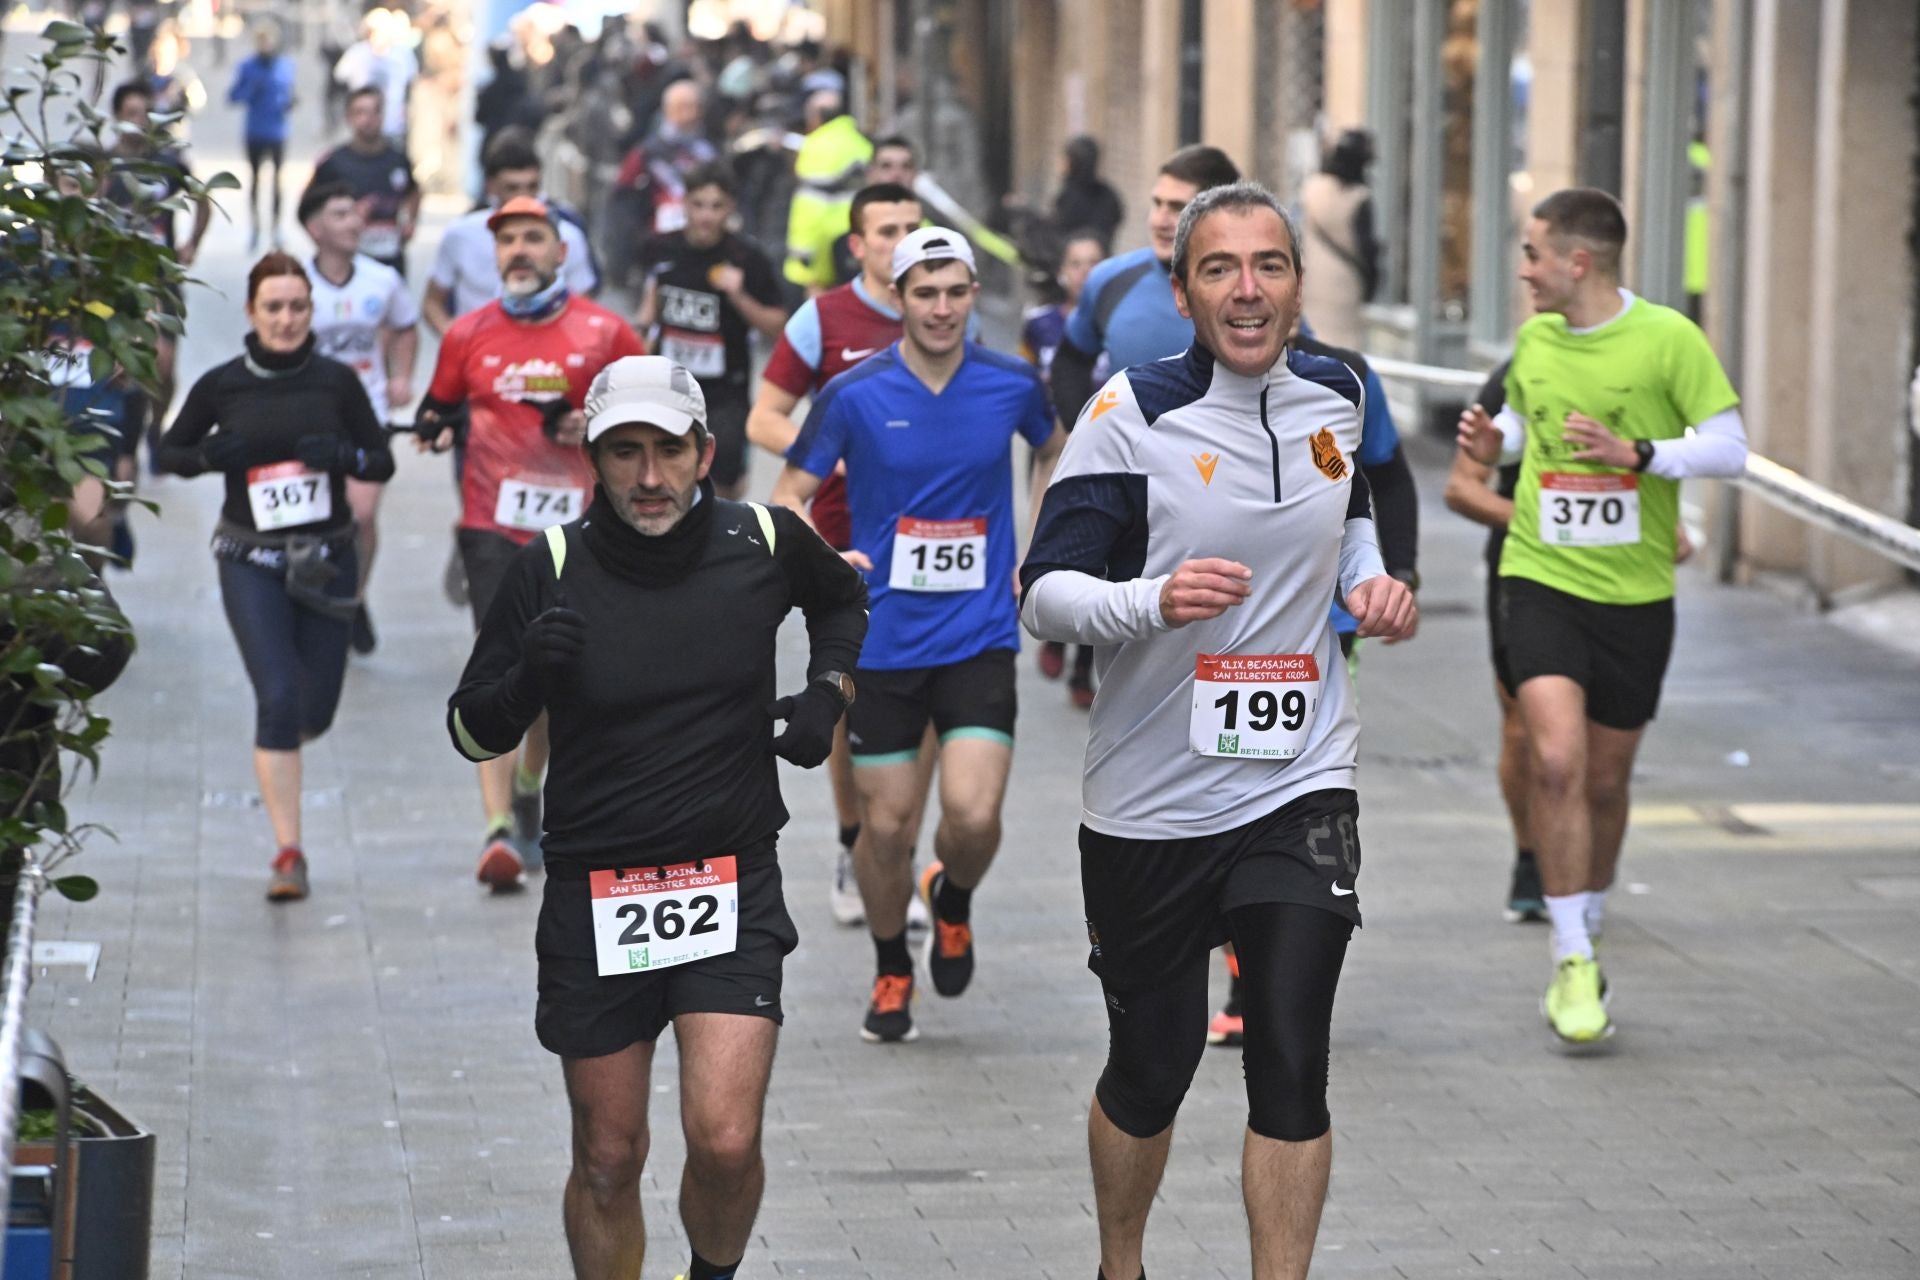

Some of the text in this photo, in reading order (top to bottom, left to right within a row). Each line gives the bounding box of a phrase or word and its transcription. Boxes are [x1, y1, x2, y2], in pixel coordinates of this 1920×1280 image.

[263, 479, 318, 510] 367
[514, 489, 569, 515] 174
[1552, 497, 1624, 525] 370
[910, 543, 975, 572] 156
[1213, 671, 1310, 680] SAN SILBESTRE KROSA
[1214, 689, 1306, 732] 199
[610, 875, 721, 895] SAN SILBESTRE KROSA
[615, 894, 720, 946] 262
